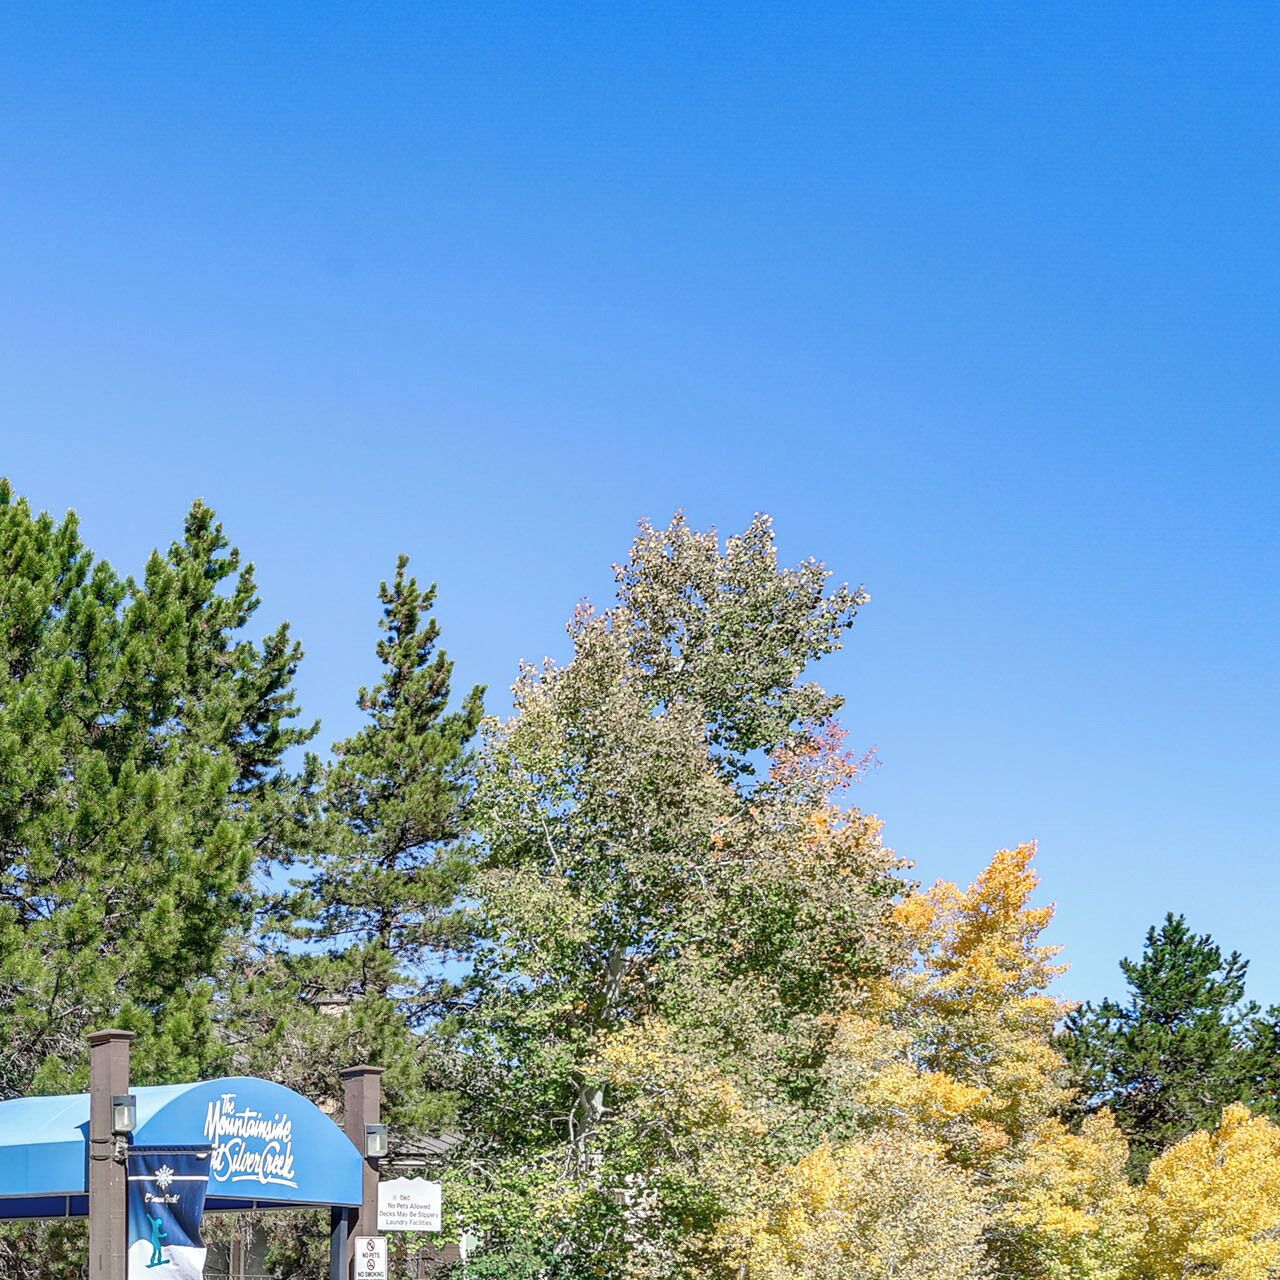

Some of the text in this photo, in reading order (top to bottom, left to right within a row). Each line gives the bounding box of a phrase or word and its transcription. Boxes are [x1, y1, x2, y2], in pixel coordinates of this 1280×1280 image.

[221, 1093, 236, 1114] The
[204, 1100, 292, 1145] Mountainside
[213, 1138, 261, 1182] Silver
[260, 1141, 295, 1183] Creek
[396, 1202, 409, 1210] Pets
[396, 1210, 408, 1218] May
[417, 1211, 439, 1219] Slippery
